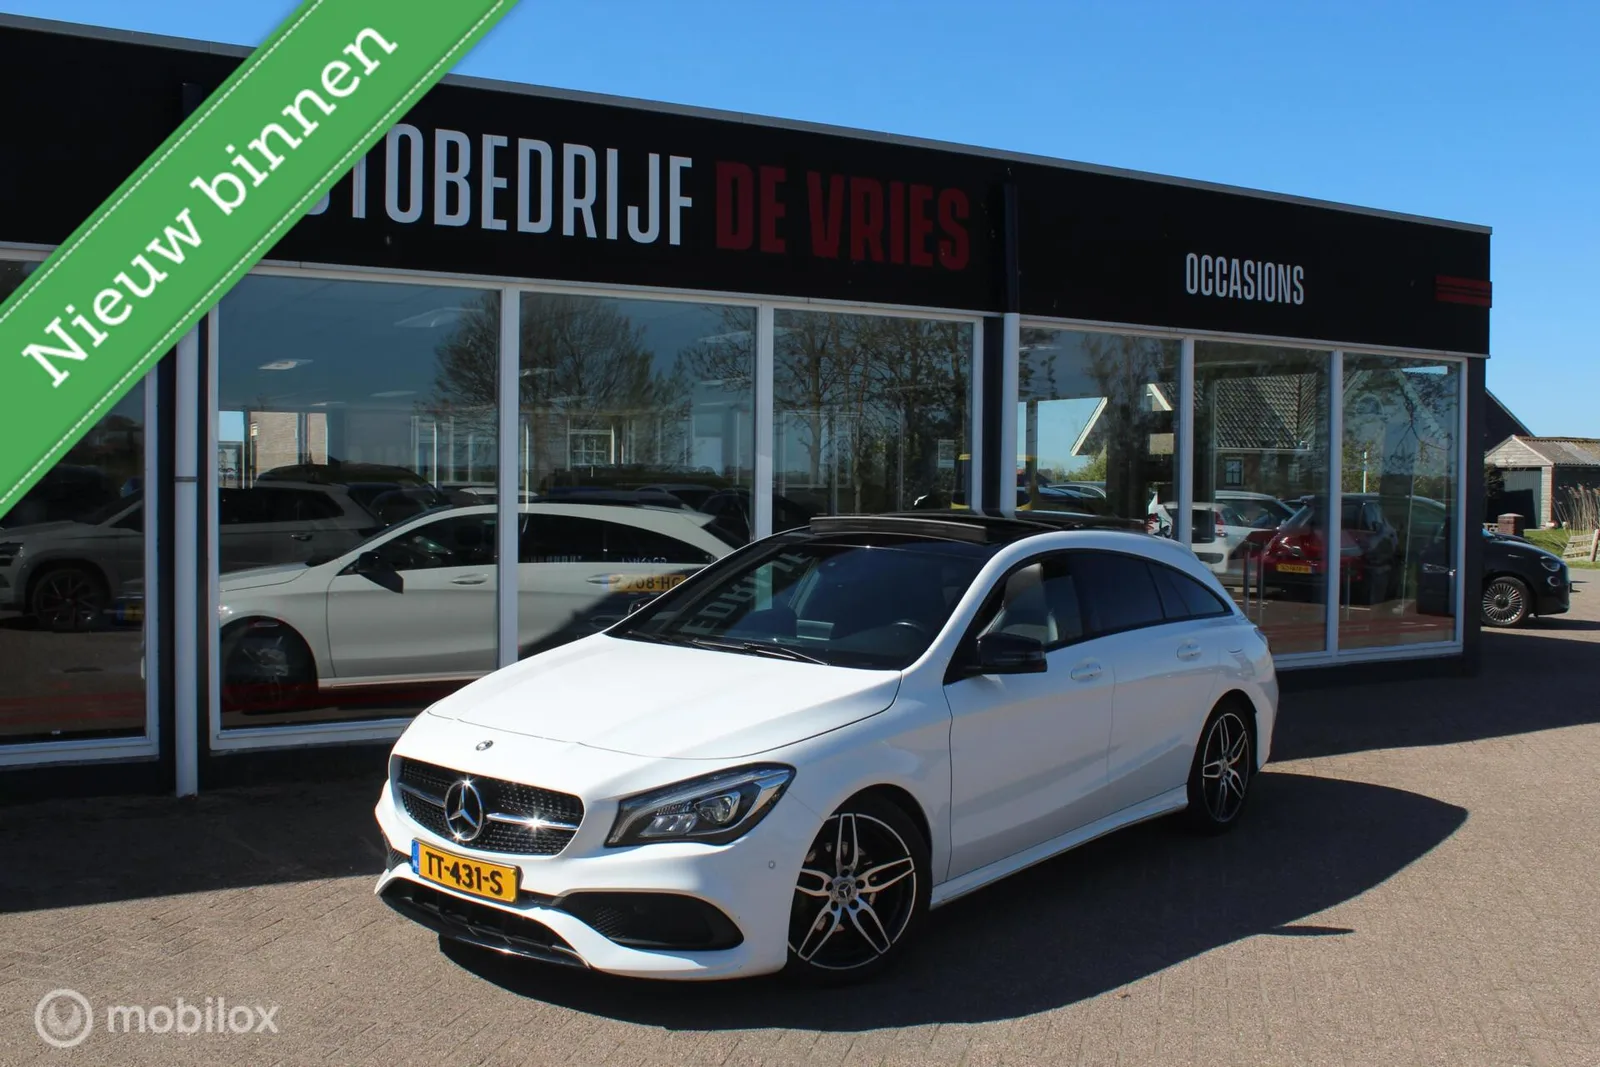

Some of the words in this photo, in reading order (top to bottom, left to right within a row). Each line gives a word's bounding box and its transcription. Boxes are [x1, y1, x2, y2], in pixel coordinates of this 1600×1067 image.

[716, 161, 786, 253] DE
[806, 170, 970, 270] VRIES
[1186, 252, 1305, 305] OCCASIONS
[425, 851, 504, 896] TT-431-S
